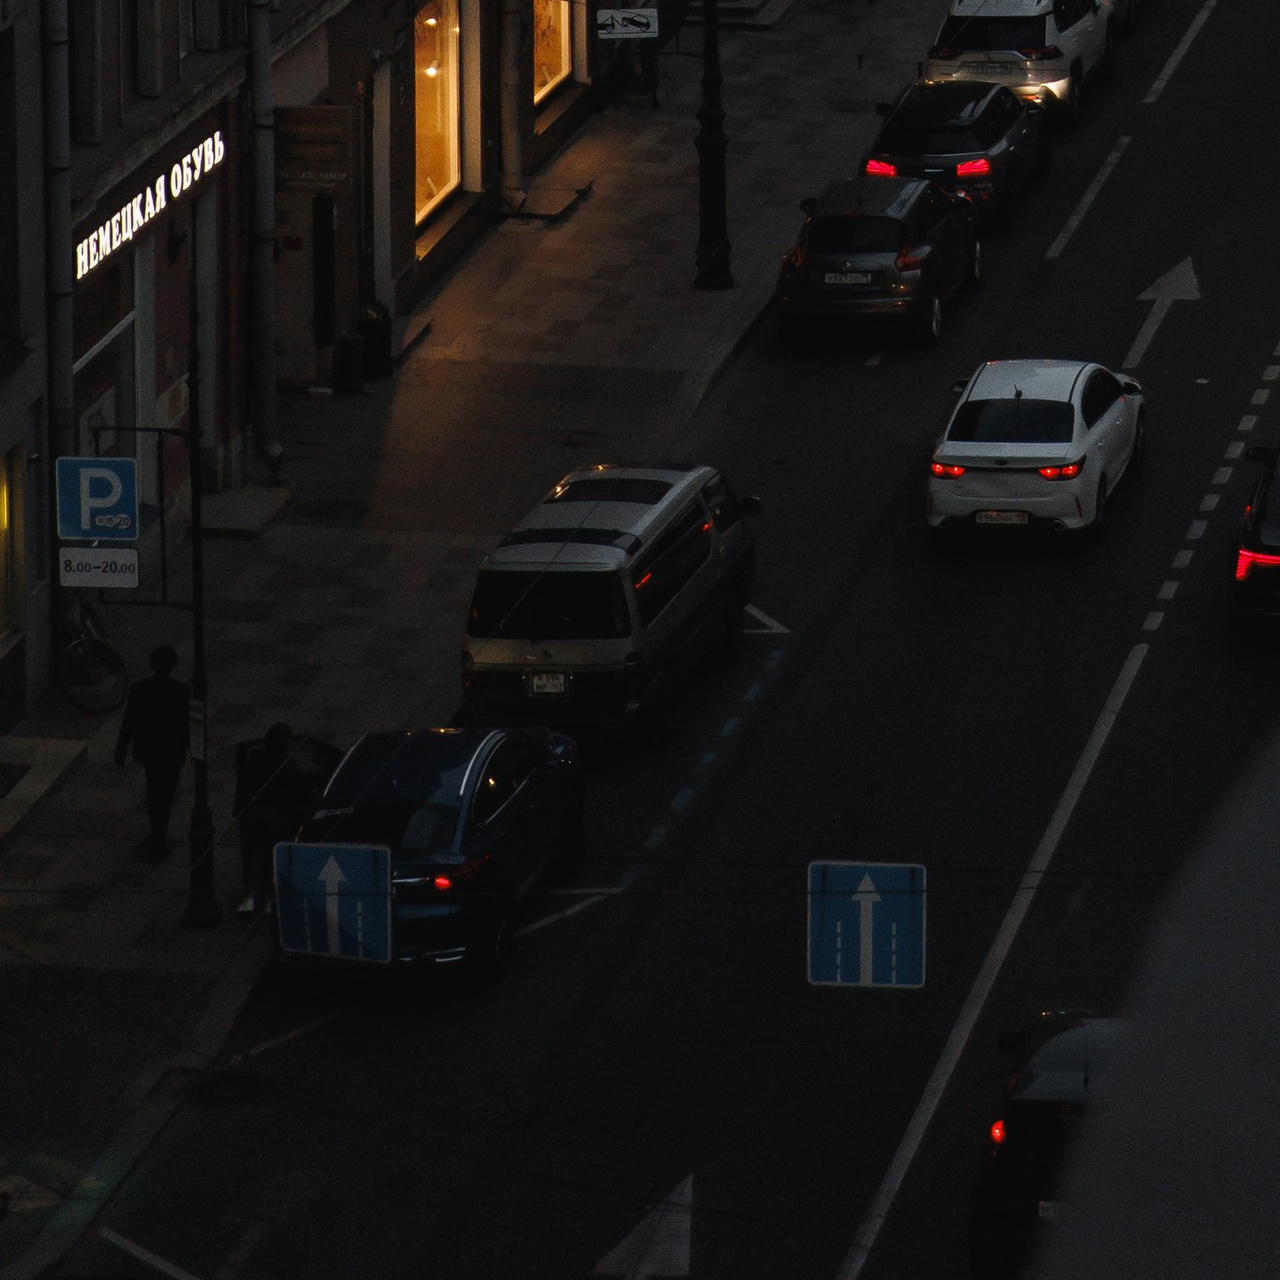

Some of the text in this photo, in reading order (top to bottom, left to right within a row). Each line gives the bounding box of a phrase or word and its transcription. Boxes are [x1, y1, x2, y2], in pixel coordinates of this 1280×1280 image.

[76, 130, 225, 280] НЕМЕЦКАЯ ОБУВЬ
[80, 467, 123, 530] P
[117, 516, 129, 527] 20
